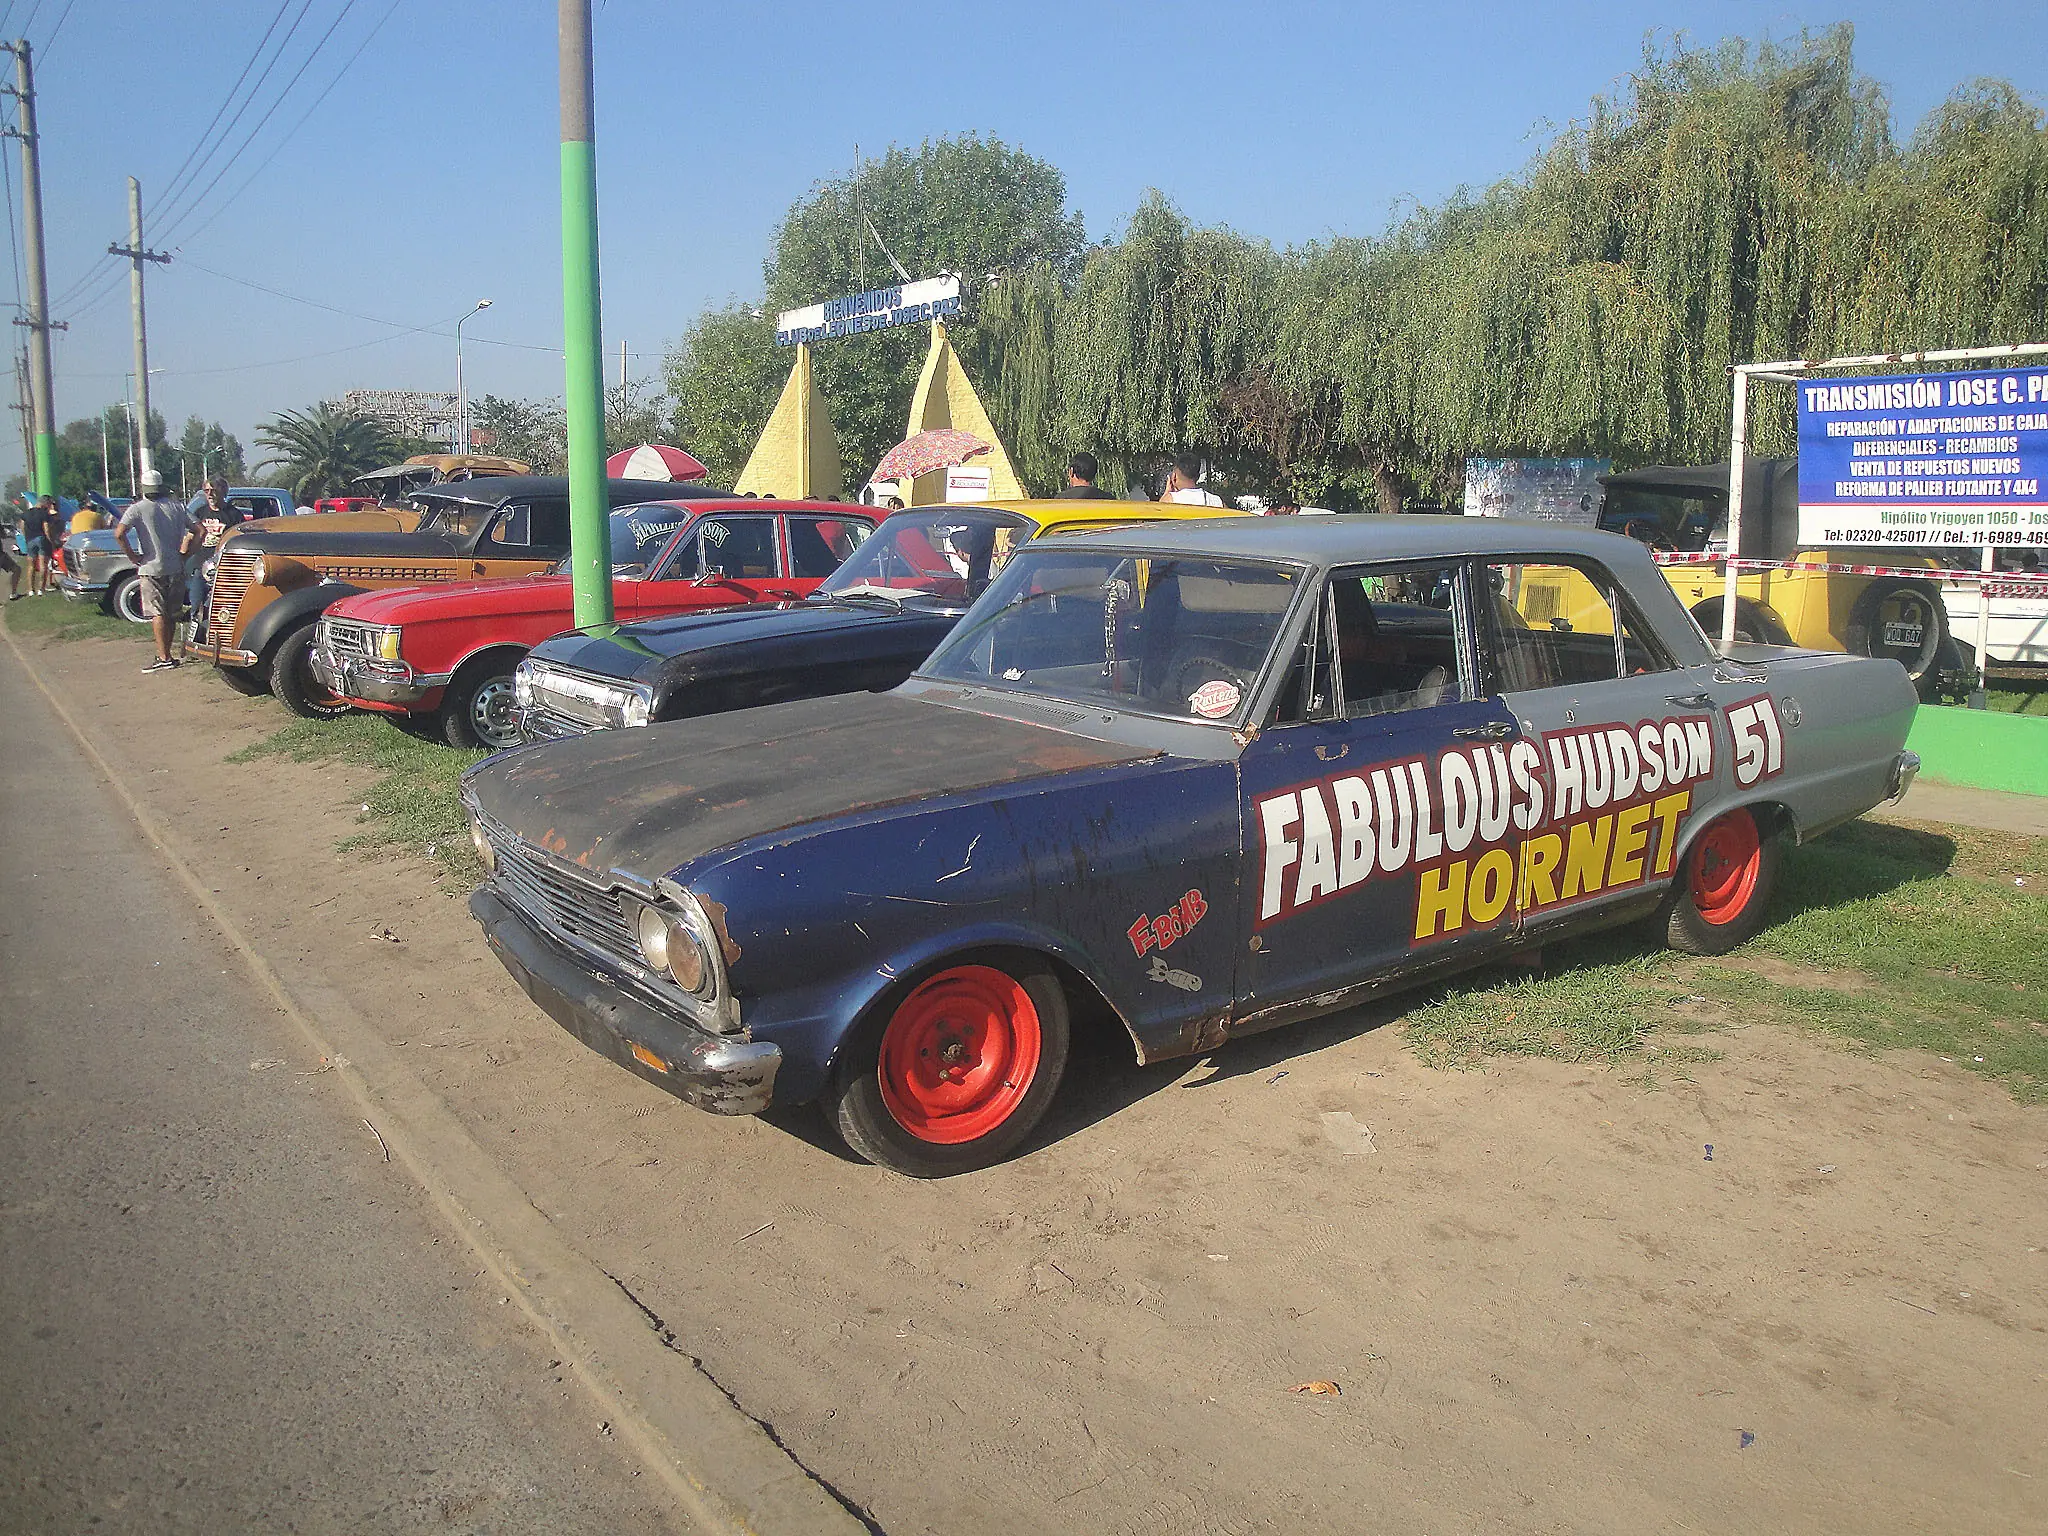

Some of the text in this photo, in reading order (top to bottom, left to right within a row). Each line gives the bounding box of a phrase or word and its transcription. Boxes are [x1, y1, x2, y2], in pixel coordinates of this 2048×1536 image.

[823, 286, 902, 322] BIENVENIDOS
[775, 326, 808, 346] CLUB
[808, 326, 822, 343] DE
[821, 315, 873, 338] LEONES
[872, 315, 887, 330] DE
[932, 295, 962, 318] PAZ
[1804, 378, 1942, 413] TRANSMISIÓN
[1947, 378, 1998, 407] JOSE
[2001, 376, 2024, 404] C.
[1826, 418, 1897, 437] REPARACIÓN
[1898, 420, 1907, 436] Y
[1907, 415, 1997, 435] ADAPTACIONES
[1998, 415, 2015, 431] DE
[1852, 439, 1937, 457] DIFERENCIALES
[1945, 436, 2018, 454] RECAMBIOS
[1849, 458, 2021, 477] VENTA DE REPUESTOS NUEVOS
[1835, 479, 2037, 497] REFORMA DE PALIER FLOTANTE Y 4X4
[1881, 510, 1927, 526] Hipólito
[1930, 511, 1984, 527] Yrigoyen
[1987, 511, 2018, 525] 1050
[1824, 529, 1843, 542] Tel:
[1845, 530, 1926, 543] 02320-425017
[1943, 530, 1970, 544] Cel.:
[1259, 698, 1782, 921] FABULOUS HUDSON 51
[1415, 790, 1690, 940] HORNET
[1127, 888, 1208, 959] F-BOMB
